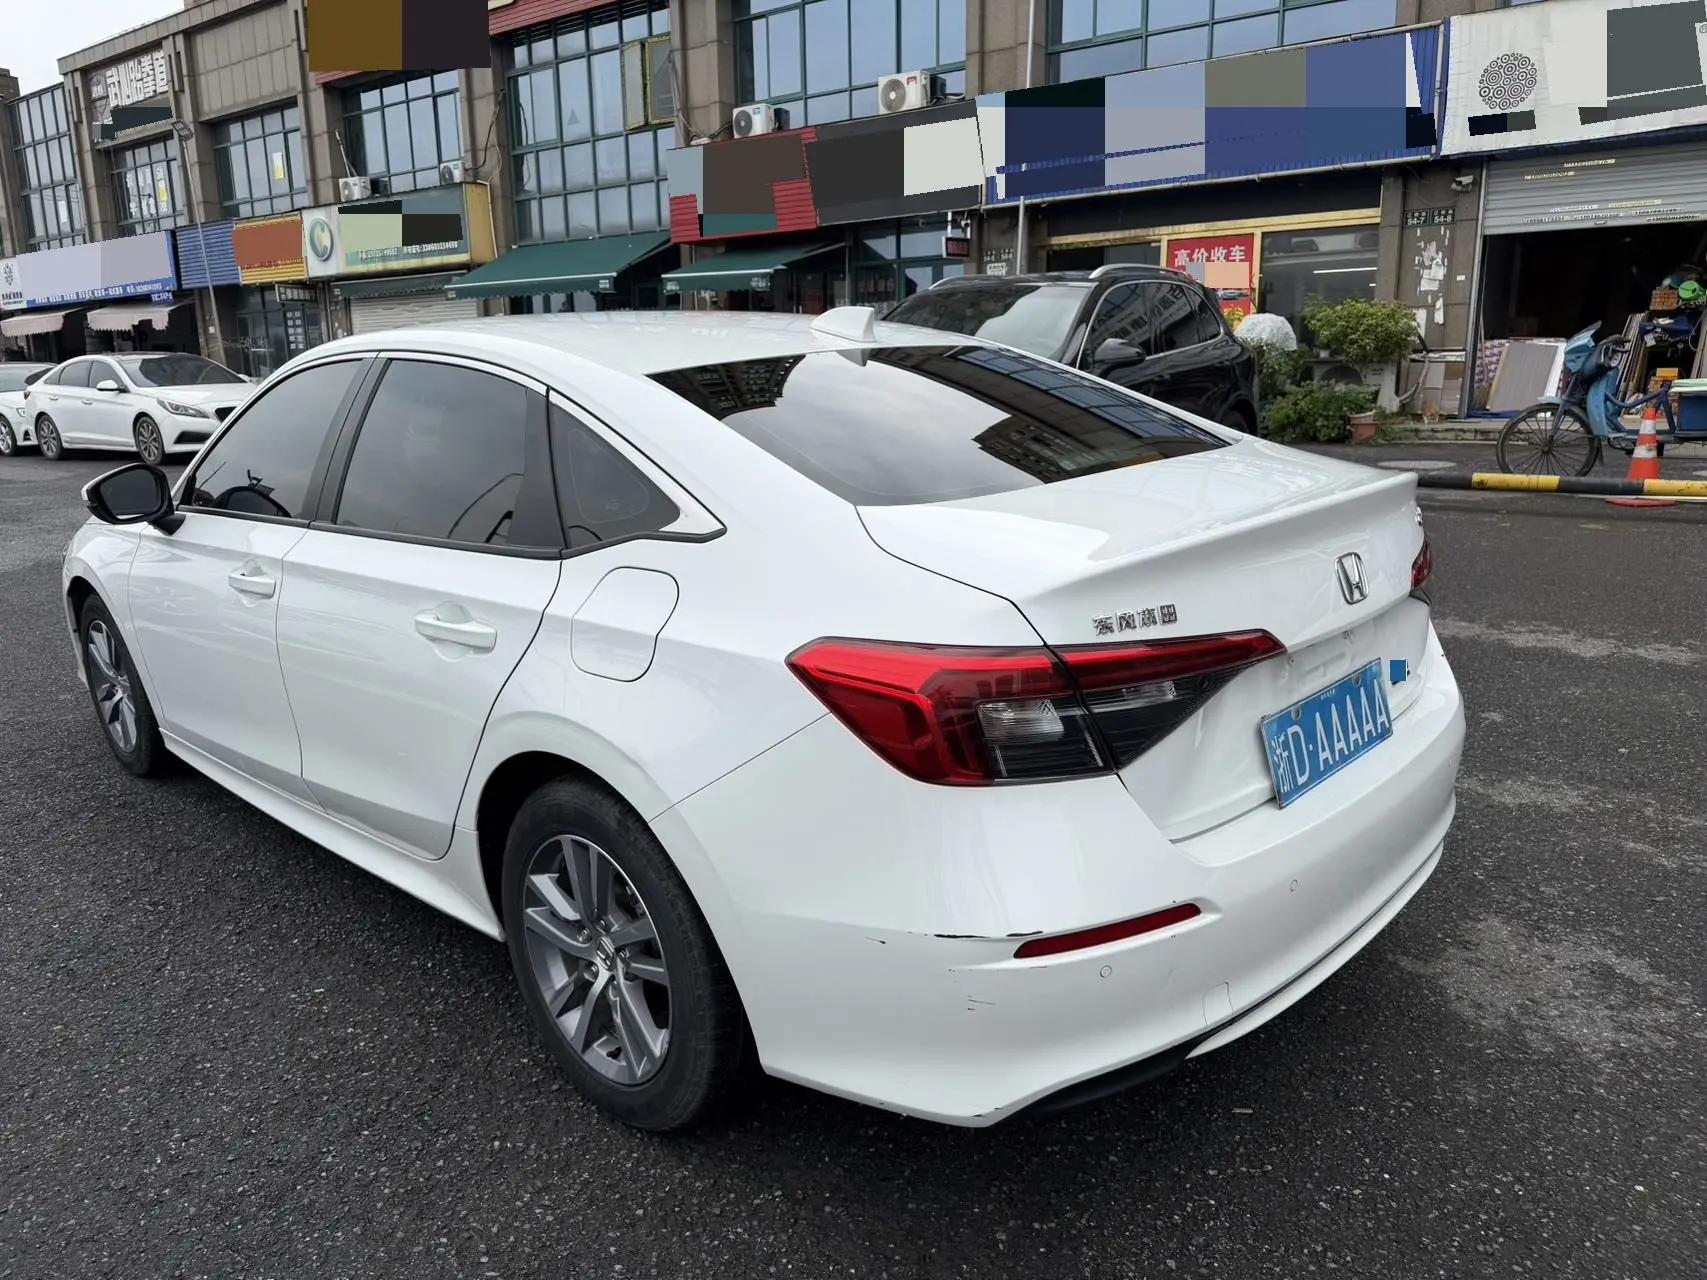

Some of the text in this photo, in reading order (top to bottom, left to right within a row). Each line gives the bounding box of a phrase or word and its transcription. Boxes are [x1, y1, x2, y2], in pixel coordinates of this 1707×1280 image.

[1174, 245, 1246, 267] 高价收车
[1092, 603, 1178, 636] 东风本田
